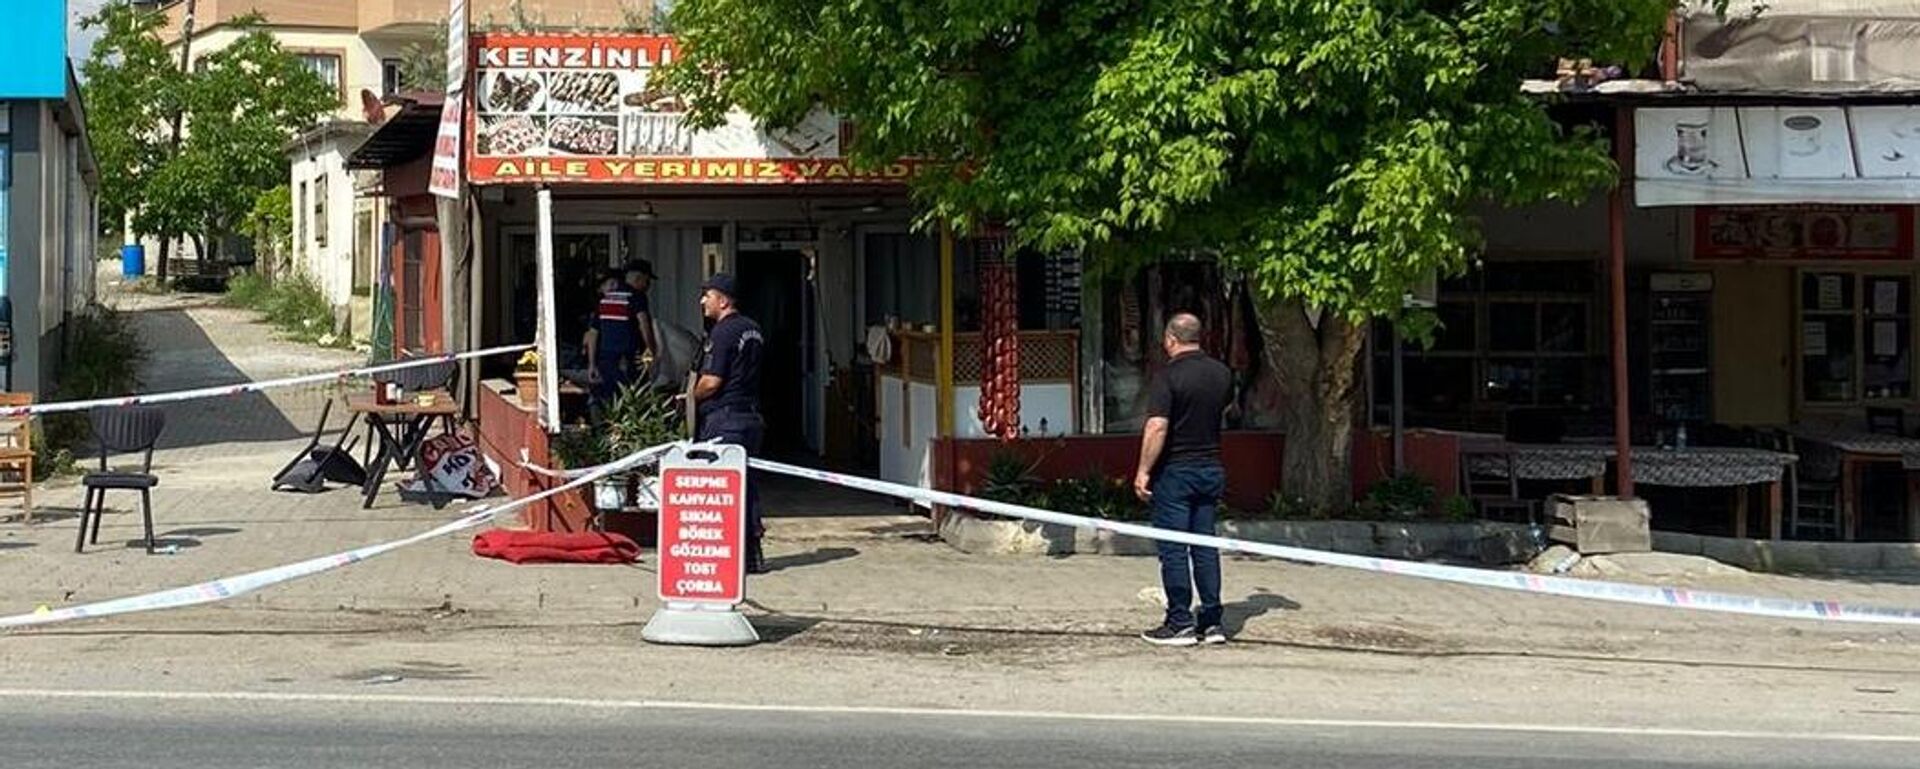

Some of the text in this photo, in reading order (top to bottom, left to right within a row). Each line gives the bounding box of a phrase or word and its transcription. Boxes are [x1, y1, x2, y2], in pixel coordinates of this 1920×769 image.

[478, 43, 672, 67] KENZİNLİ
[495, 158, 588, 176] AİLE
[605, 158, 783, 177] YERİMİZ
[675, 475, 729, 488] SERPME
[668, 493, 734, 506] KAHYALTI
[679, 510, 723, 523] SIKMA
[678, 524, 724, 540] BÖREK
[669, 542, 732, 558] GÖZLEME
[683, 562, 718, 575] TOST
[675, 580, 724, 595] ÇORBA
